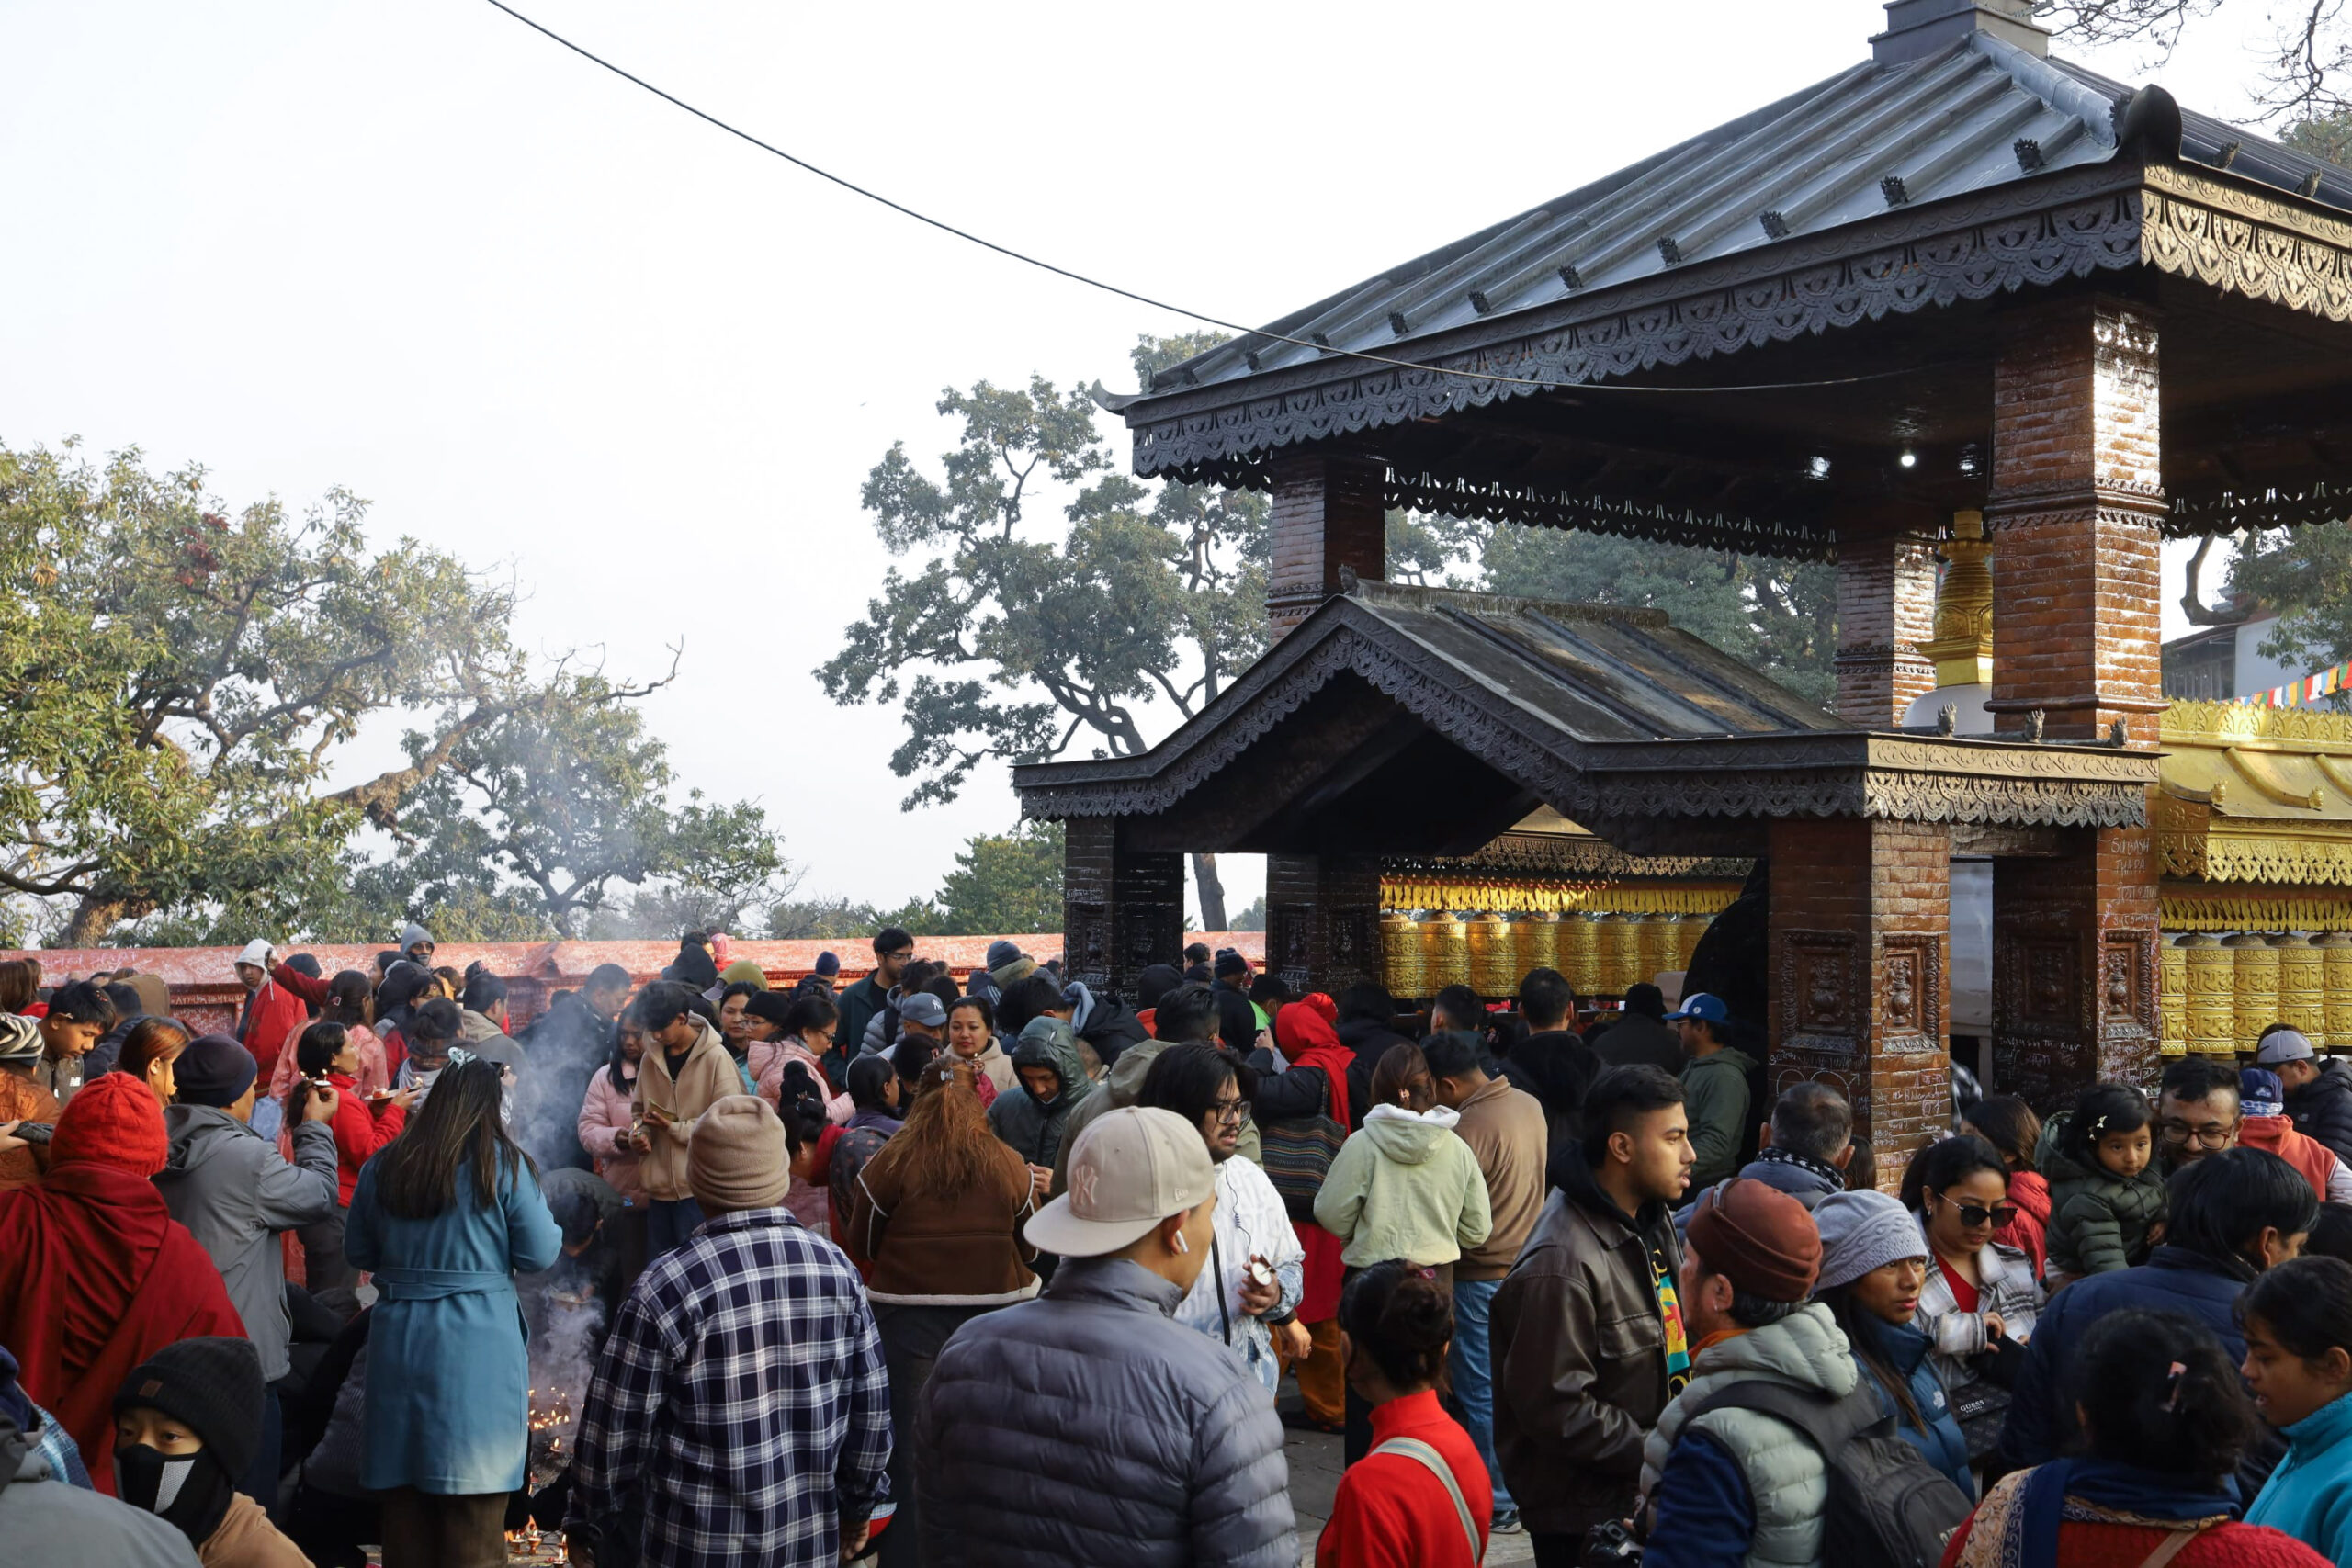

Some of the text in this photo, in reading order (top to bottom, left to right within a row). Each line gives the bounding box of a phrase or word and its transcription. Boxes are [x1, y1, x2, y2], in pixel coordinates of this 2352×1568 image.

[2111, 837, 2150, 855] SUBASH
[1071, 1164, 1100, 1206] NY
[1960, 1399, 1984, 1412] GUESS
